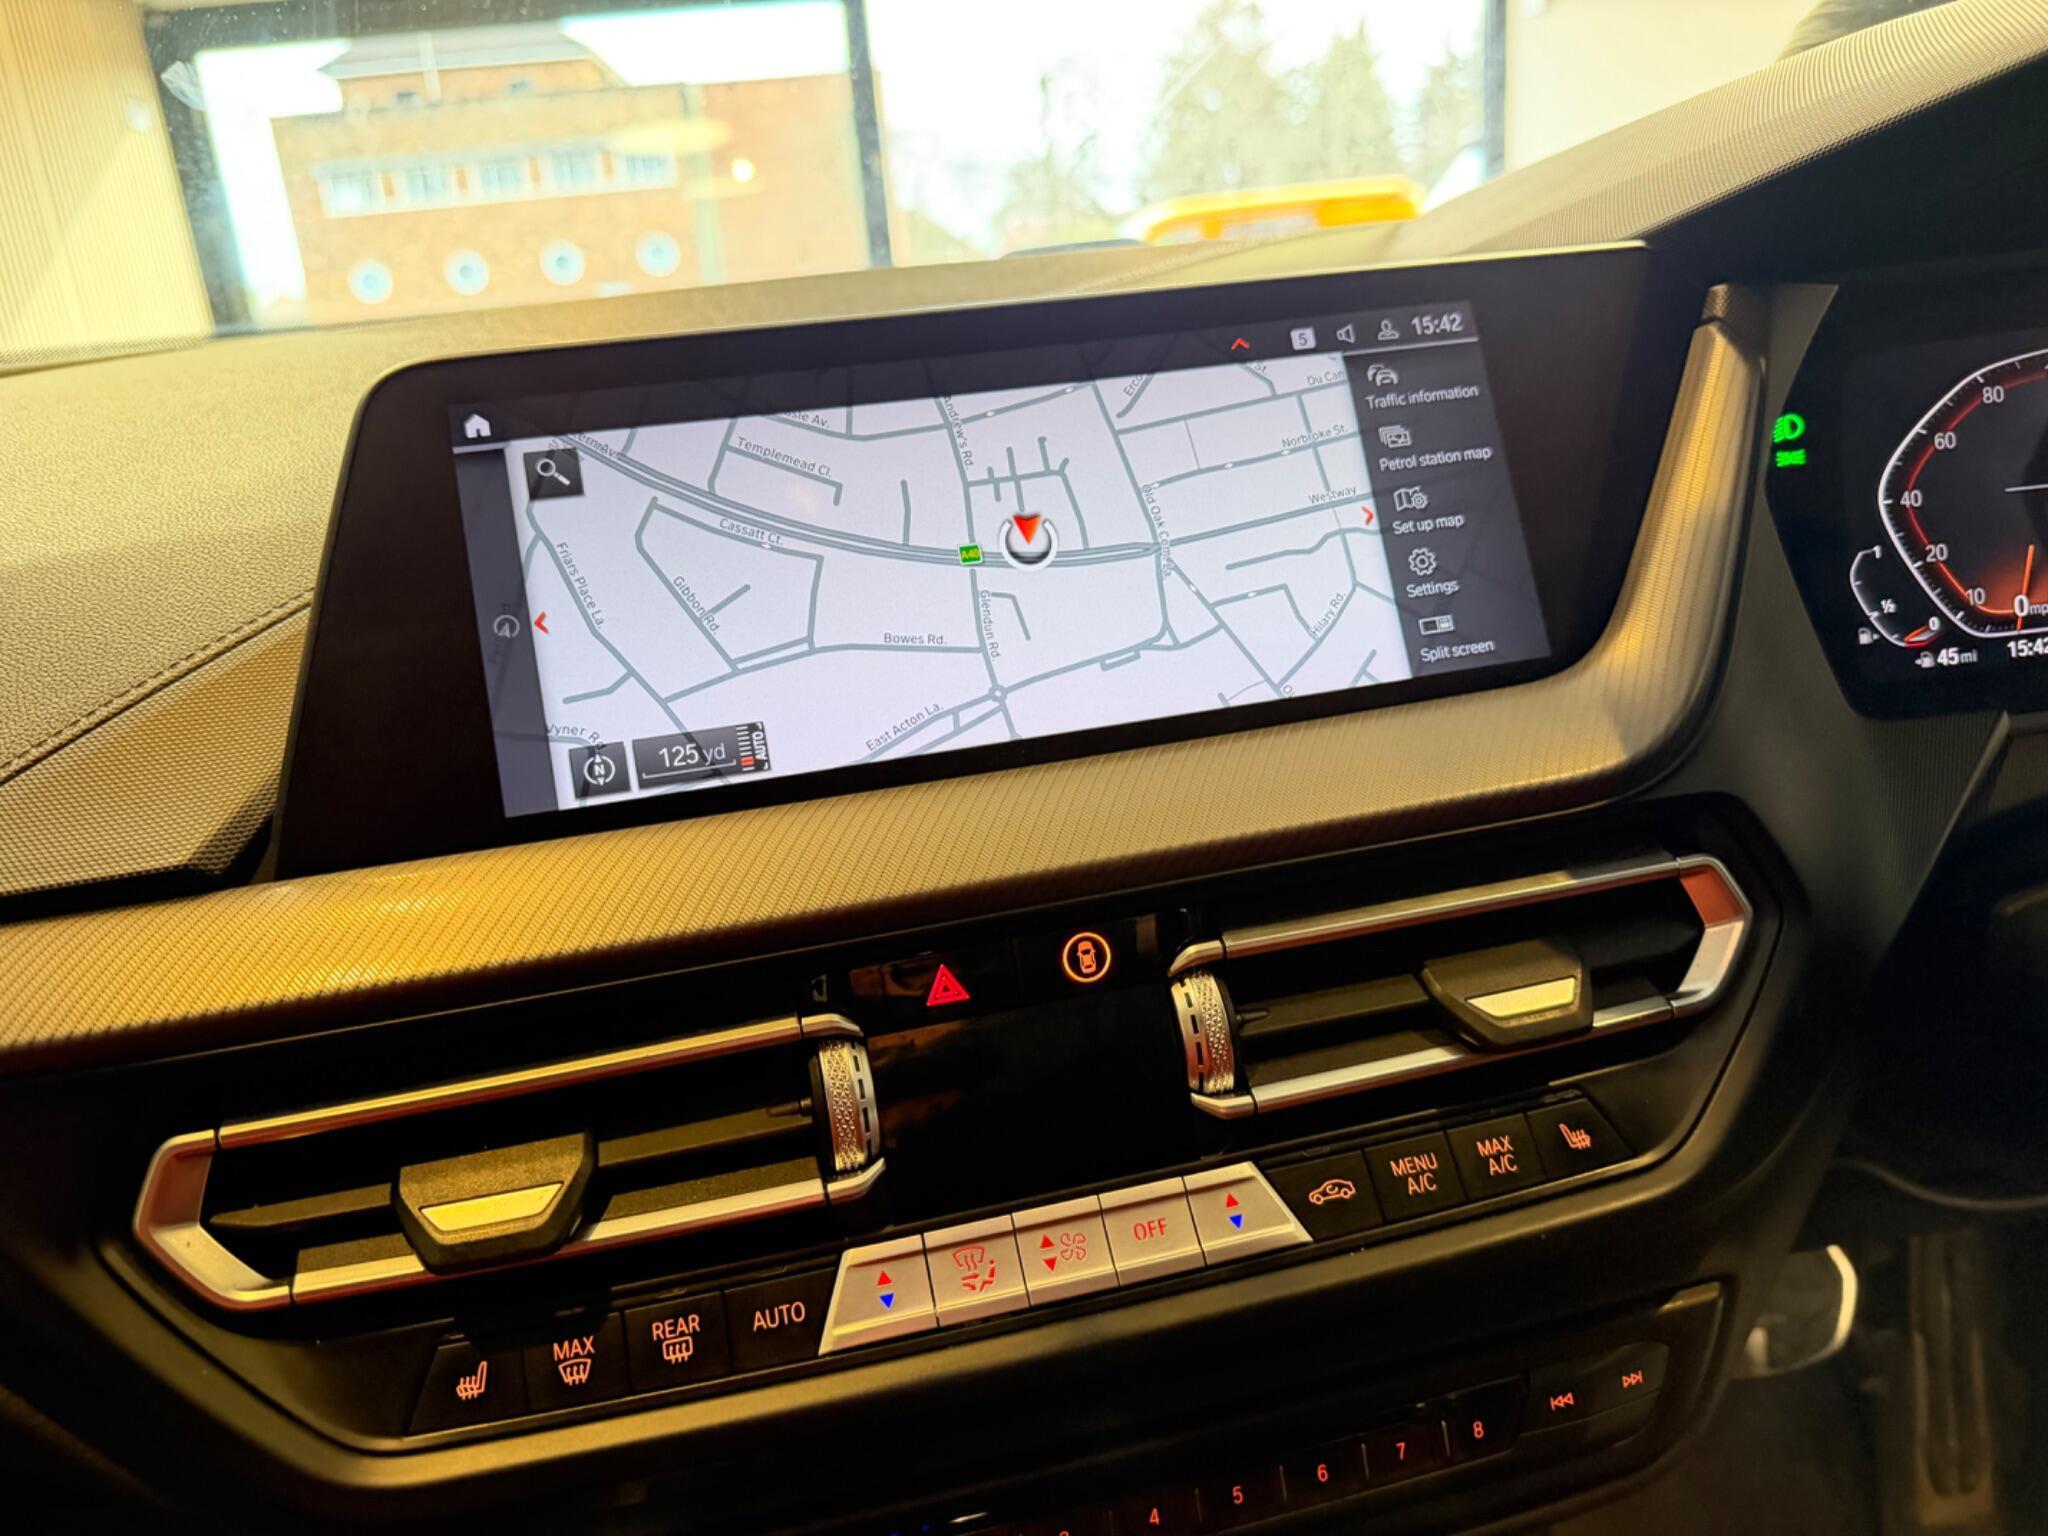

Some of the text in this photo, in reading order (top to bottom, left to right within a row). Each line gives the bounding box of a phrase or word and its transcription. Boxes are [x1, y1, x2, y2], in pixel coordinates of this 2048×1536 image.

[1411, 312, 1463, 337] 15:42
[1299, 331, 1309, 346] 5
[1365, 384, 1479, 410] Traffic information
[1983, 386, 2004, 404] 80
[1934, 432, 1957, 450] 60
[738, 436, 816, 472] Templemead
[1380, 446, 1493, 472] Petrol station map
[1309, 487, 1357, 504] Westway
[1900, 489, 1923, 508] 40
[719, 517, 765, 540] Cassatt
[1393, 514, 1465, 535] Set up map
[1925, 543, 1948, 563] 20
[556, 541, 579, 577] Friars
[574, 576, 597, 611] Place
[1406, 580, 1460, 598] Settings
[1965, 587, 1986, 606] 10
[673, 575, 721, 636] Gibbon Rd.
[1928, 616, 1941, 631] 0
[884, 632, 948, 646] Bowes Rd.
[1420, 640, 1495, 664] Split screen
[866, 730, 893, 751] East
[892, 711, 926, 736] Acton
[658, 742, 727, 768] 125 yd
[752, 731, 768, 760] AUTO
[594, 764, 606, 776] N
[1476, 1135, 1514, 1157] MAX
[1390, 1151, 1438, 1177] MENU
[1488, 1153, 1518, 1176] A/C
[1407, 1172, 1437, 1196] A/C
[1133, 1218, 1168, 1242] OFF
[652, 1313, 701, 1341] REAR
[753, 1301, 806, 1332] AUTO
[552, 1335, 596, 1362] MAX
[1473, 1420, 1485, 1439] 8
[1395, 1442, 1407, 1461] 7
[1316, 1463, 1329, 1483] 6
[1232, 1486, 1244, 1505] 5
[1149, 1508, 1161, 1526] 4
